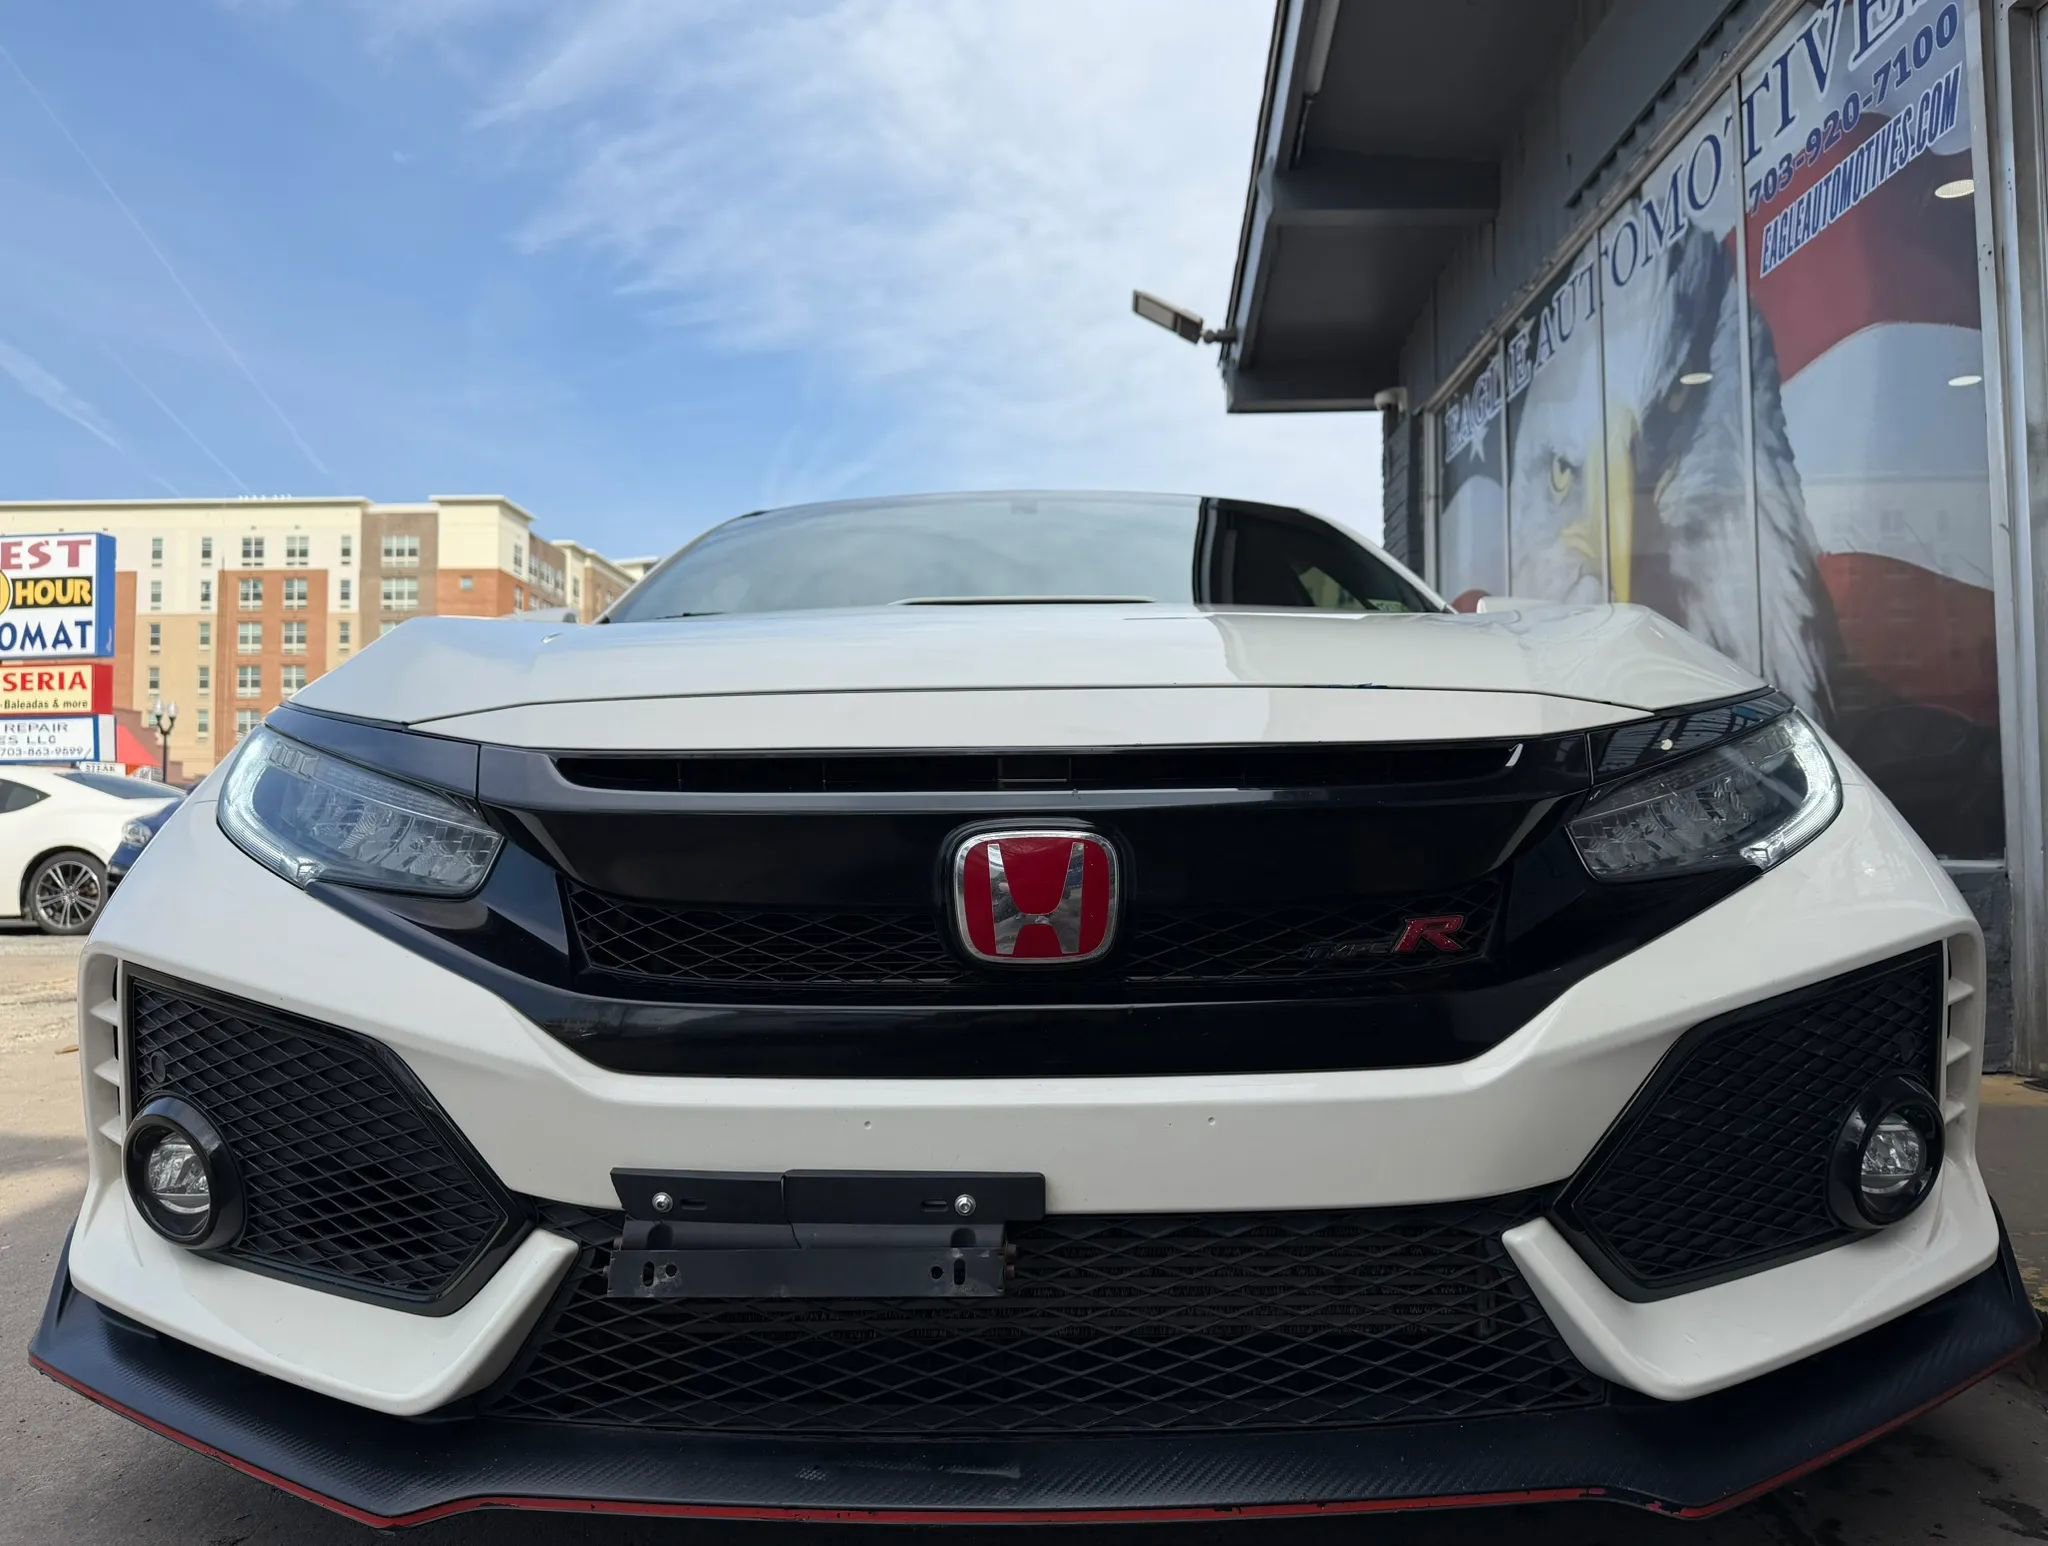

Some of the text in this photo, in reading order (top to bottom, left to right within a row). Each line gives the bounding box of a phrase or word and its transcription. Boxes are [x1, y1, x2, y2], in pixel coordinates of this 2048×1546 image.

[1749, 3, 1959, 216] 703-920-7100
[1534, 0, 1924, 368] AUTOMOTIVE
[1760, 62, 1963, 278] EAGLEAUTOMOTIVES.COM
[15, 577, 92, 606] HOUR
[0, 620, 93, 651] OMAT
[2, 670, 88, 692] SERIA
[52, 697, 59, 709] &
[63, 700, 88, 709] more
[4, 722, 69, 734] REPAIR
[26, 735, 57, 745] LLC
[1392, 914, 1467, 953] R
